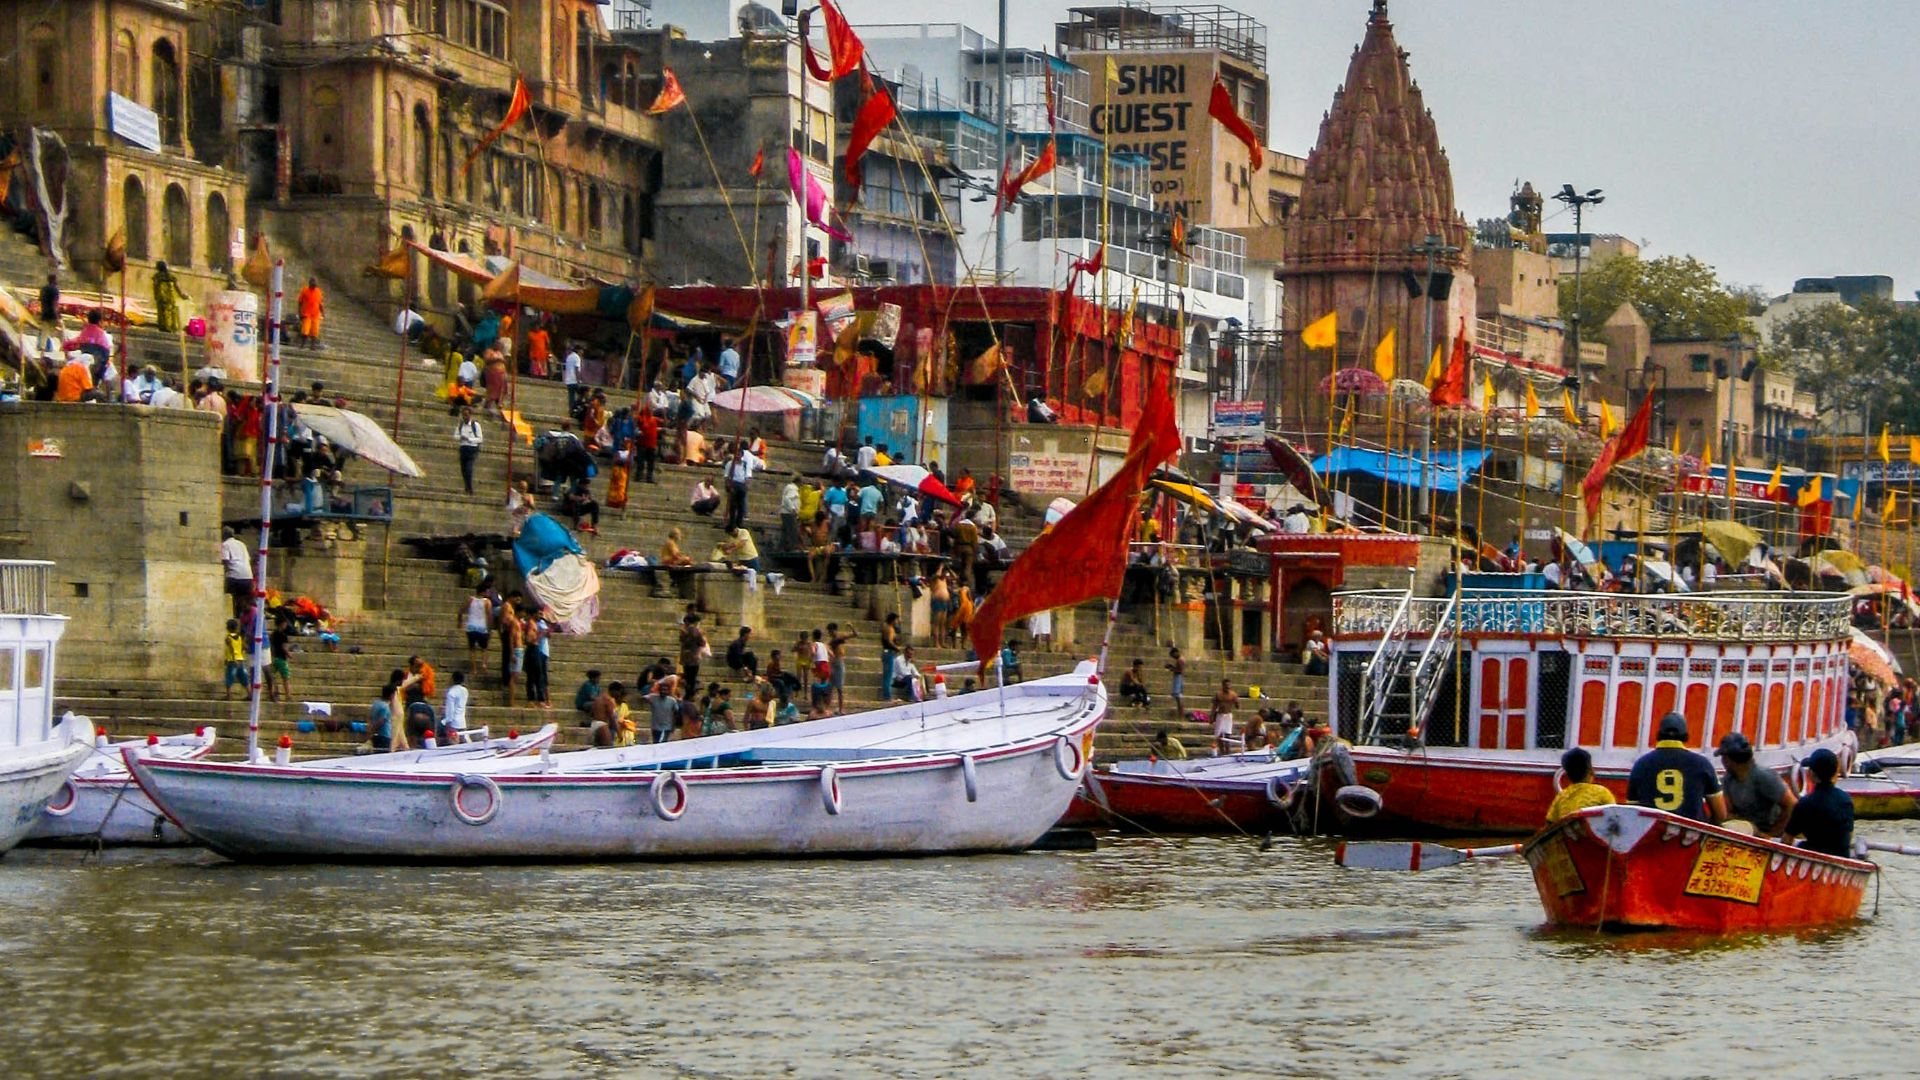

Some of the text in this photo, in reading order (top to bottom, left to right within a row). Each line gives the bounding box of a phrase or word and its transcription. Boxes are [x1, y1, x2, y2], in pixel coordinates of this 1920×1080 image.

[1117, 64, 1185, 95] SHRI
[1090, 102, 1192, 135] GUEST
[1654, 769, 1684, 811] 9
